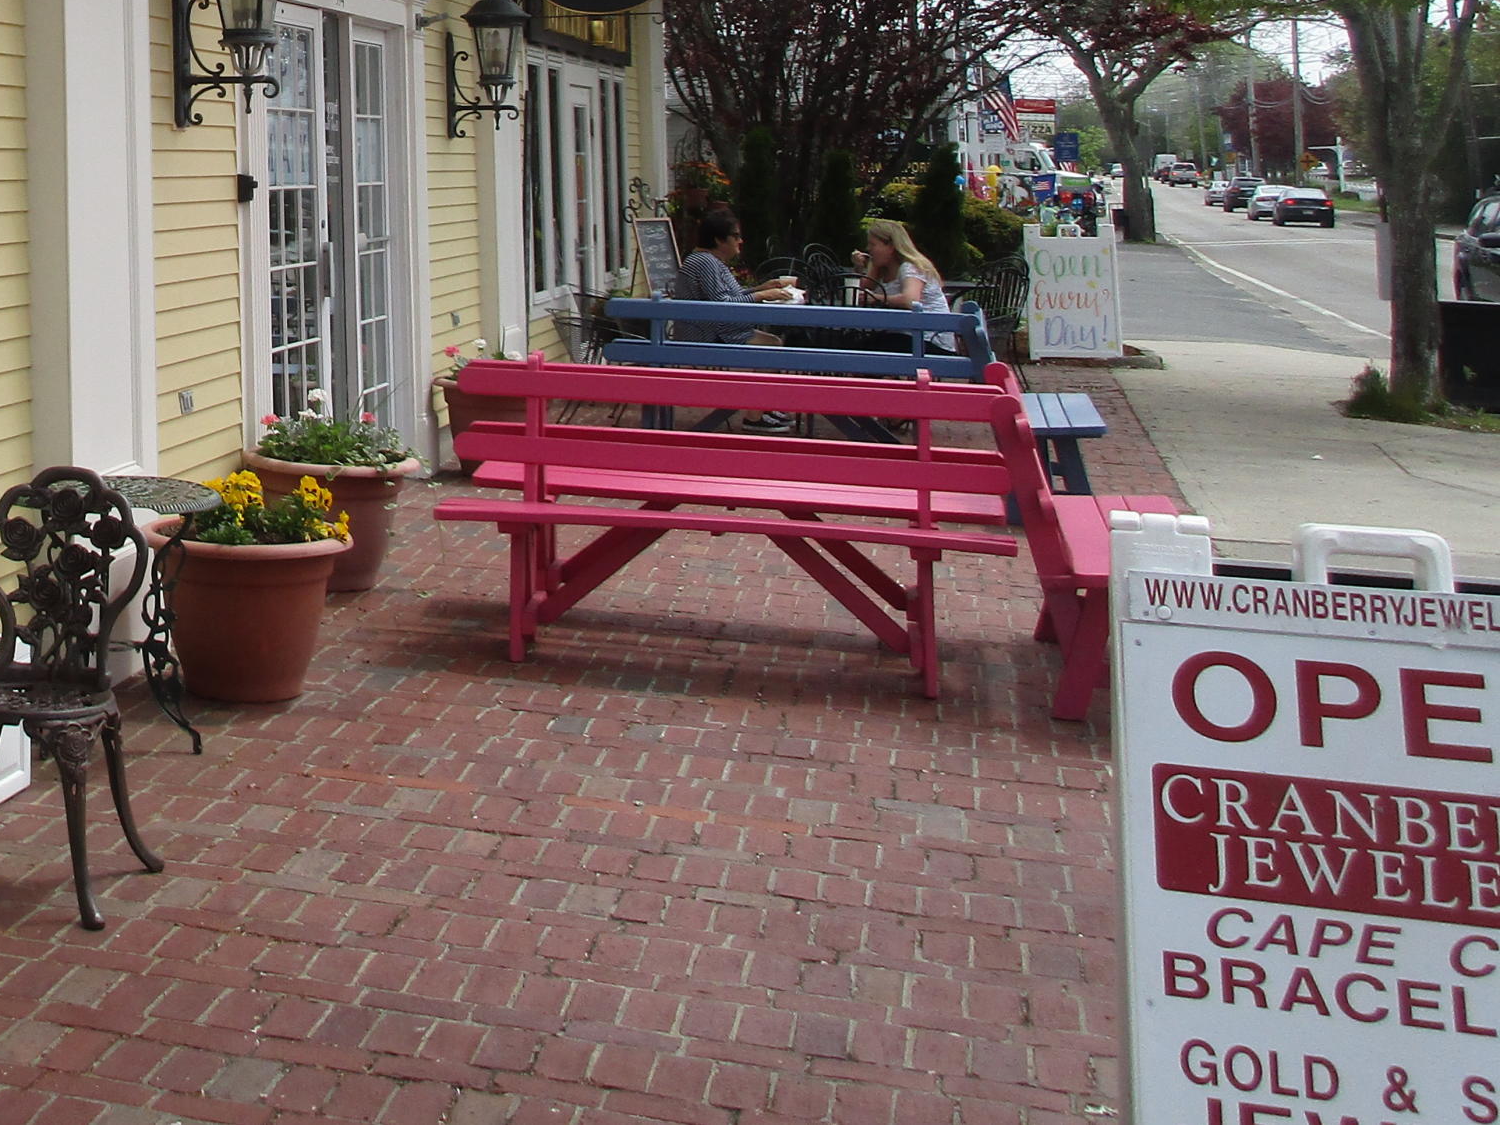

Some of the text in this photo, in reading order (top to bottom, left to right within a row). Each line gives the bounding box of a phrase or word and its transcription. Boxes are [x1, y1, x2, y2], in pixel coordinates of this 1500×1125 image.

[1033, 249, 1103, 283] Open
[1034, 280, 1110, 317] Every
[1044, 315, 1107, 350] Day!
[1145, 578, 1500, 632] WWW.CRANBERRYJEWEL
[1172, 650, 1494, 764] OPE
[1206, 907, 1402, 966] CAPE
[1162, 950, 1499, 1037] BRACEL
[1180, 1038, 1340, 1102] GOLD
[1382, 1065, 1419, 1115] &
